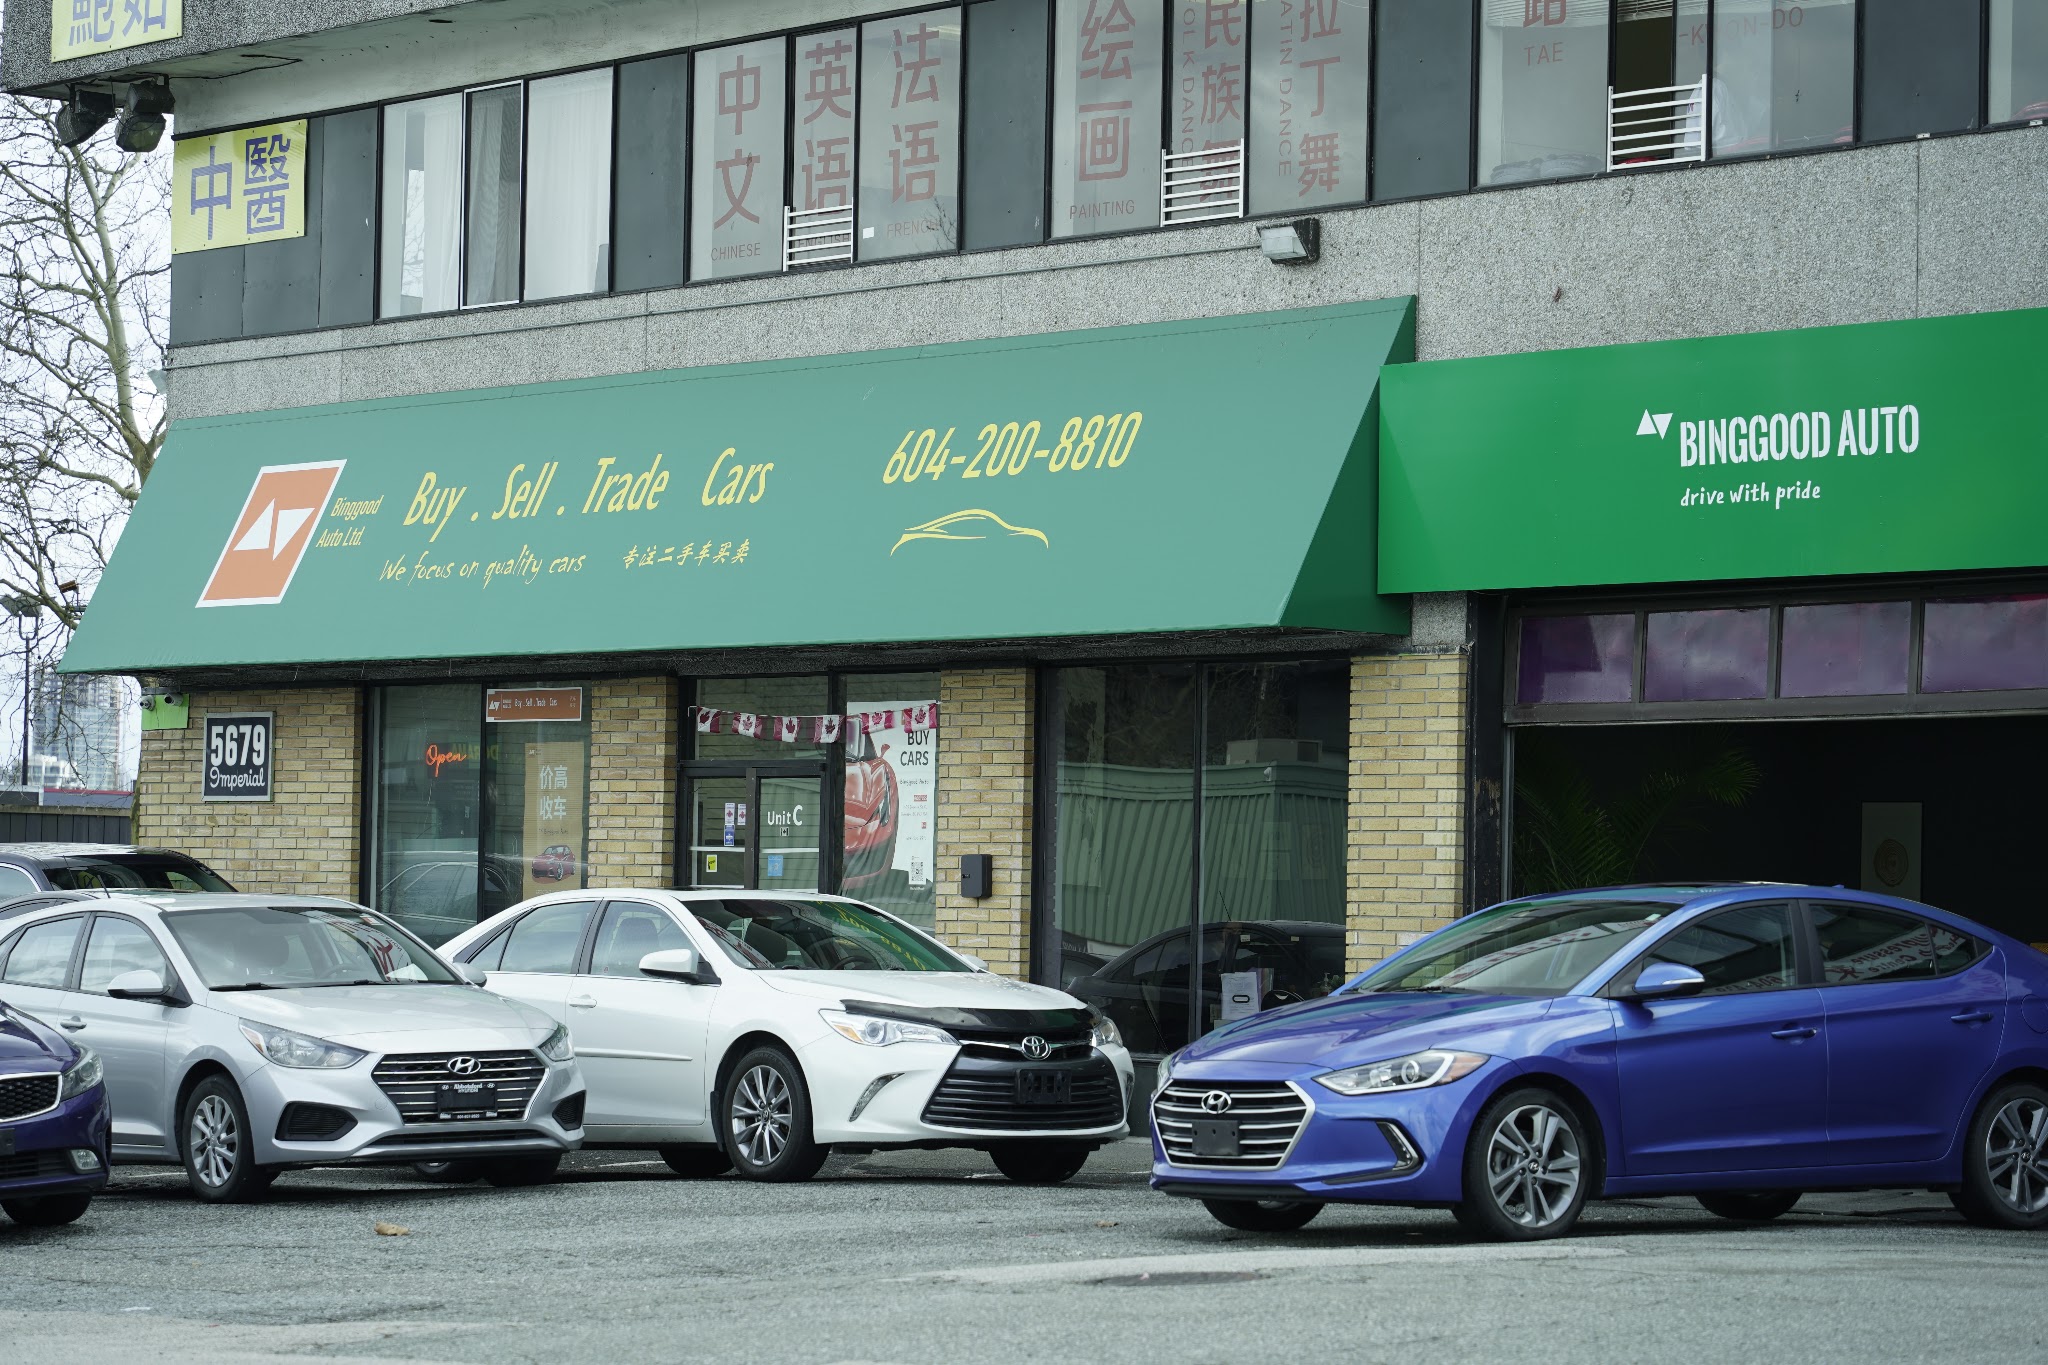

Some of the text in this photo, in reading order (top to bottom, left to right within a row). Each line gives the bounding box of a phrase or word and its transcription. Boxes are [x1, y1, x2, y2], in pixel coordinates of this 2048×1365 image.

[1523, 41, 1565, 67] TAE
[1279, 0, 1293, 177] ATIN DANCE
[801, 39, 853, 217] 英语
[888, 22, 941, 204] 法语
[1181, 77, 1195, 168] DANCE
[713, 54, 761, 230] 中文
[1069, 199, 1135, 219] PAINTING
[886, 219, 940, 239] FRENCH
[710, 242, 761, 261] CHINESE
[883, 411, 1143, 484] 604-200-8810
[1680, 404, 1919, 467] BINGGOOD AUTO
[330, 495, 384, 521] Binggood
[403, 471, 468, 543] Buy
[492, 462, 558, 520] Sell
[582, 453, 670, 513] Trade
[701, 447, 774, 506] Cars
[1680, 486, 1725, 507] drive
[1775, 480, 1821, 510] pride
[316, 526, 366, 548] Auto Ltd.
[379, 544, 587, 590] We focus on quality cars
[210, 724, 266, 767] 5679
[907, 730, 930, 746] BUY
[425, 743, 467, 778] Open
[900, 750, 929, 766] CARS
[209, 766, 266, 792] Imperial
[540, 795, 567, 820] 收车
[767, 810, 791, 826] Unit
[792, 804, 803, 827] C
